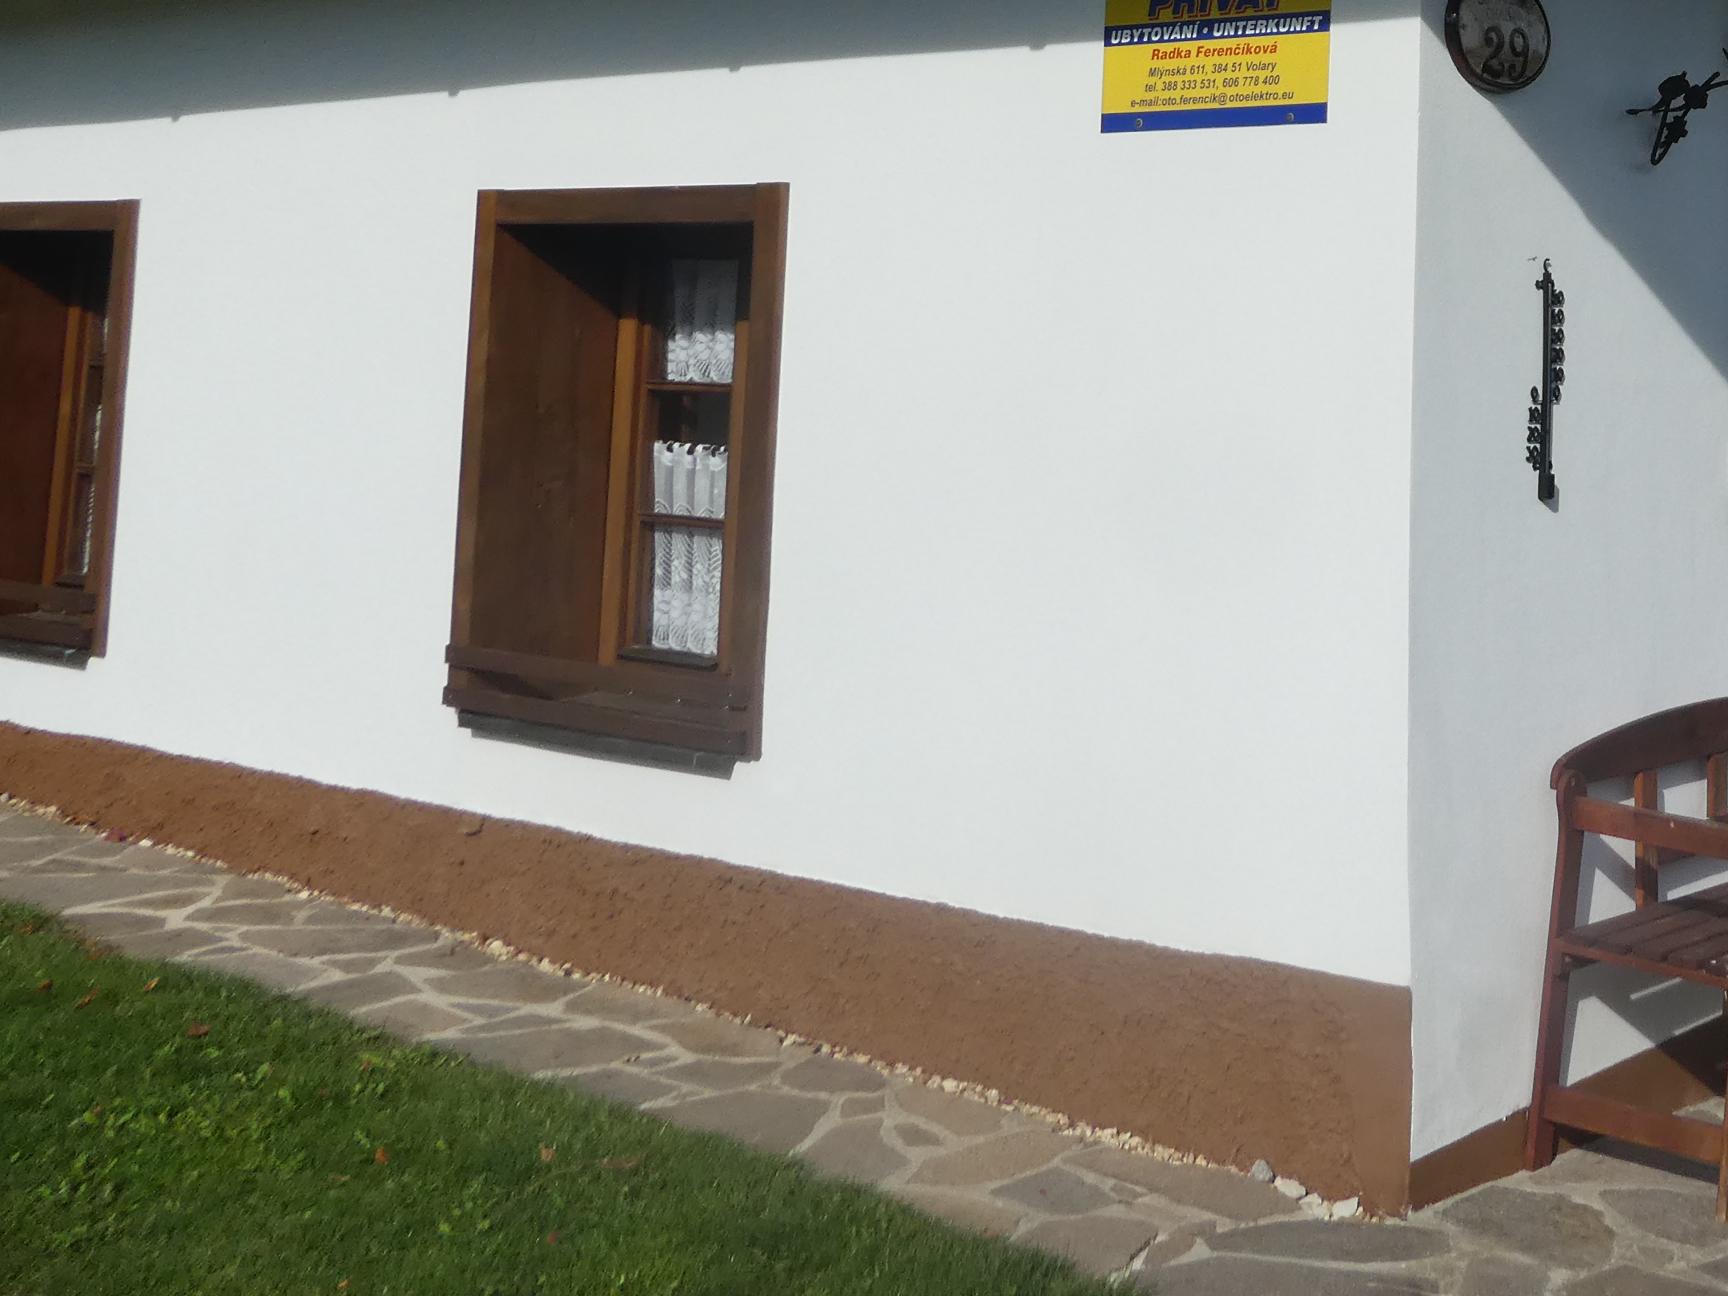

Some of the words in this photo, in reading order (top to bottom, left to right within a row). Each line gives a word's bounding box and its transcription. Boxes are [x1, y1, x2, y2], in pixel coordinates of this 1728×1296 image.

[1111, 21, 1200, 44] UBYTOVÁNÍ
[1213, 16, 1322, 37] UNTERKUNFT
[1151, 47, 1192, 61] Radka
[1481, 25, 1530, 81] 29
[1189, 64, 1208, 75] 611,
[1211, 63, 1229, 74] 384
[1231, 62, 1243, 73] 51
[1246, 61, 1277, 73] Volary
[1144, 81, 1159, 93] tel.
[1161, 80, 1178, 92] 388
[1180, 79, 1198, 91] 333
[1200, 78, 1219, 91] 531,
[1222, 77, 1240, 88] 606
[1242, 75, 1260, 87] 778
[1262, 74, 1281, 86] 400
